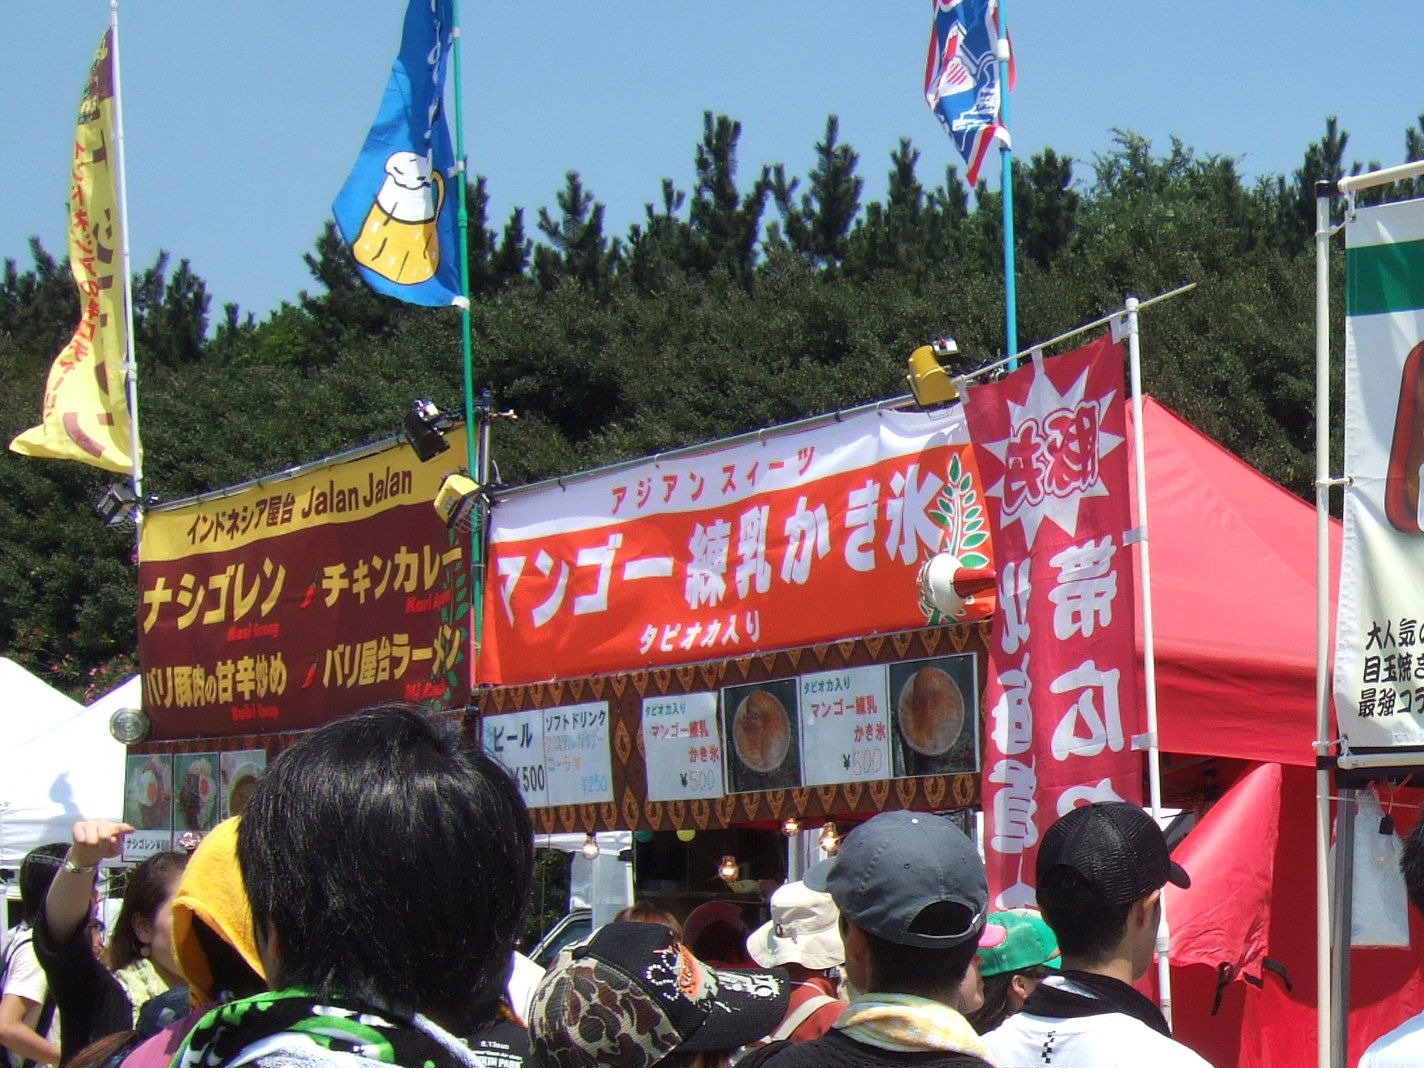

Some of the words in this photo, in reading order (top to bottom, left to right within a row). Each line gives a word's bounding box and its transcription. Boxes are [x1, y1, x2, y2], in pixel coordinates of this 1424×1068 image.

[188, 493, 295, 546] インドネシア屋台
[302, 480, 360, 519] Jalan
[363, 466, 413, 509] Jalan
[143, 556, 287, 634] ナシゴレン
[321, 544, 464, 608] チキンカレー
[322, 623, 460, 689] バリ屋台ラーメン
[640, 610, 761, 657] タピオカ入り
[494, 722, 533, 752] ビール
[545, 709, 605, 732] ソフトドリンク
